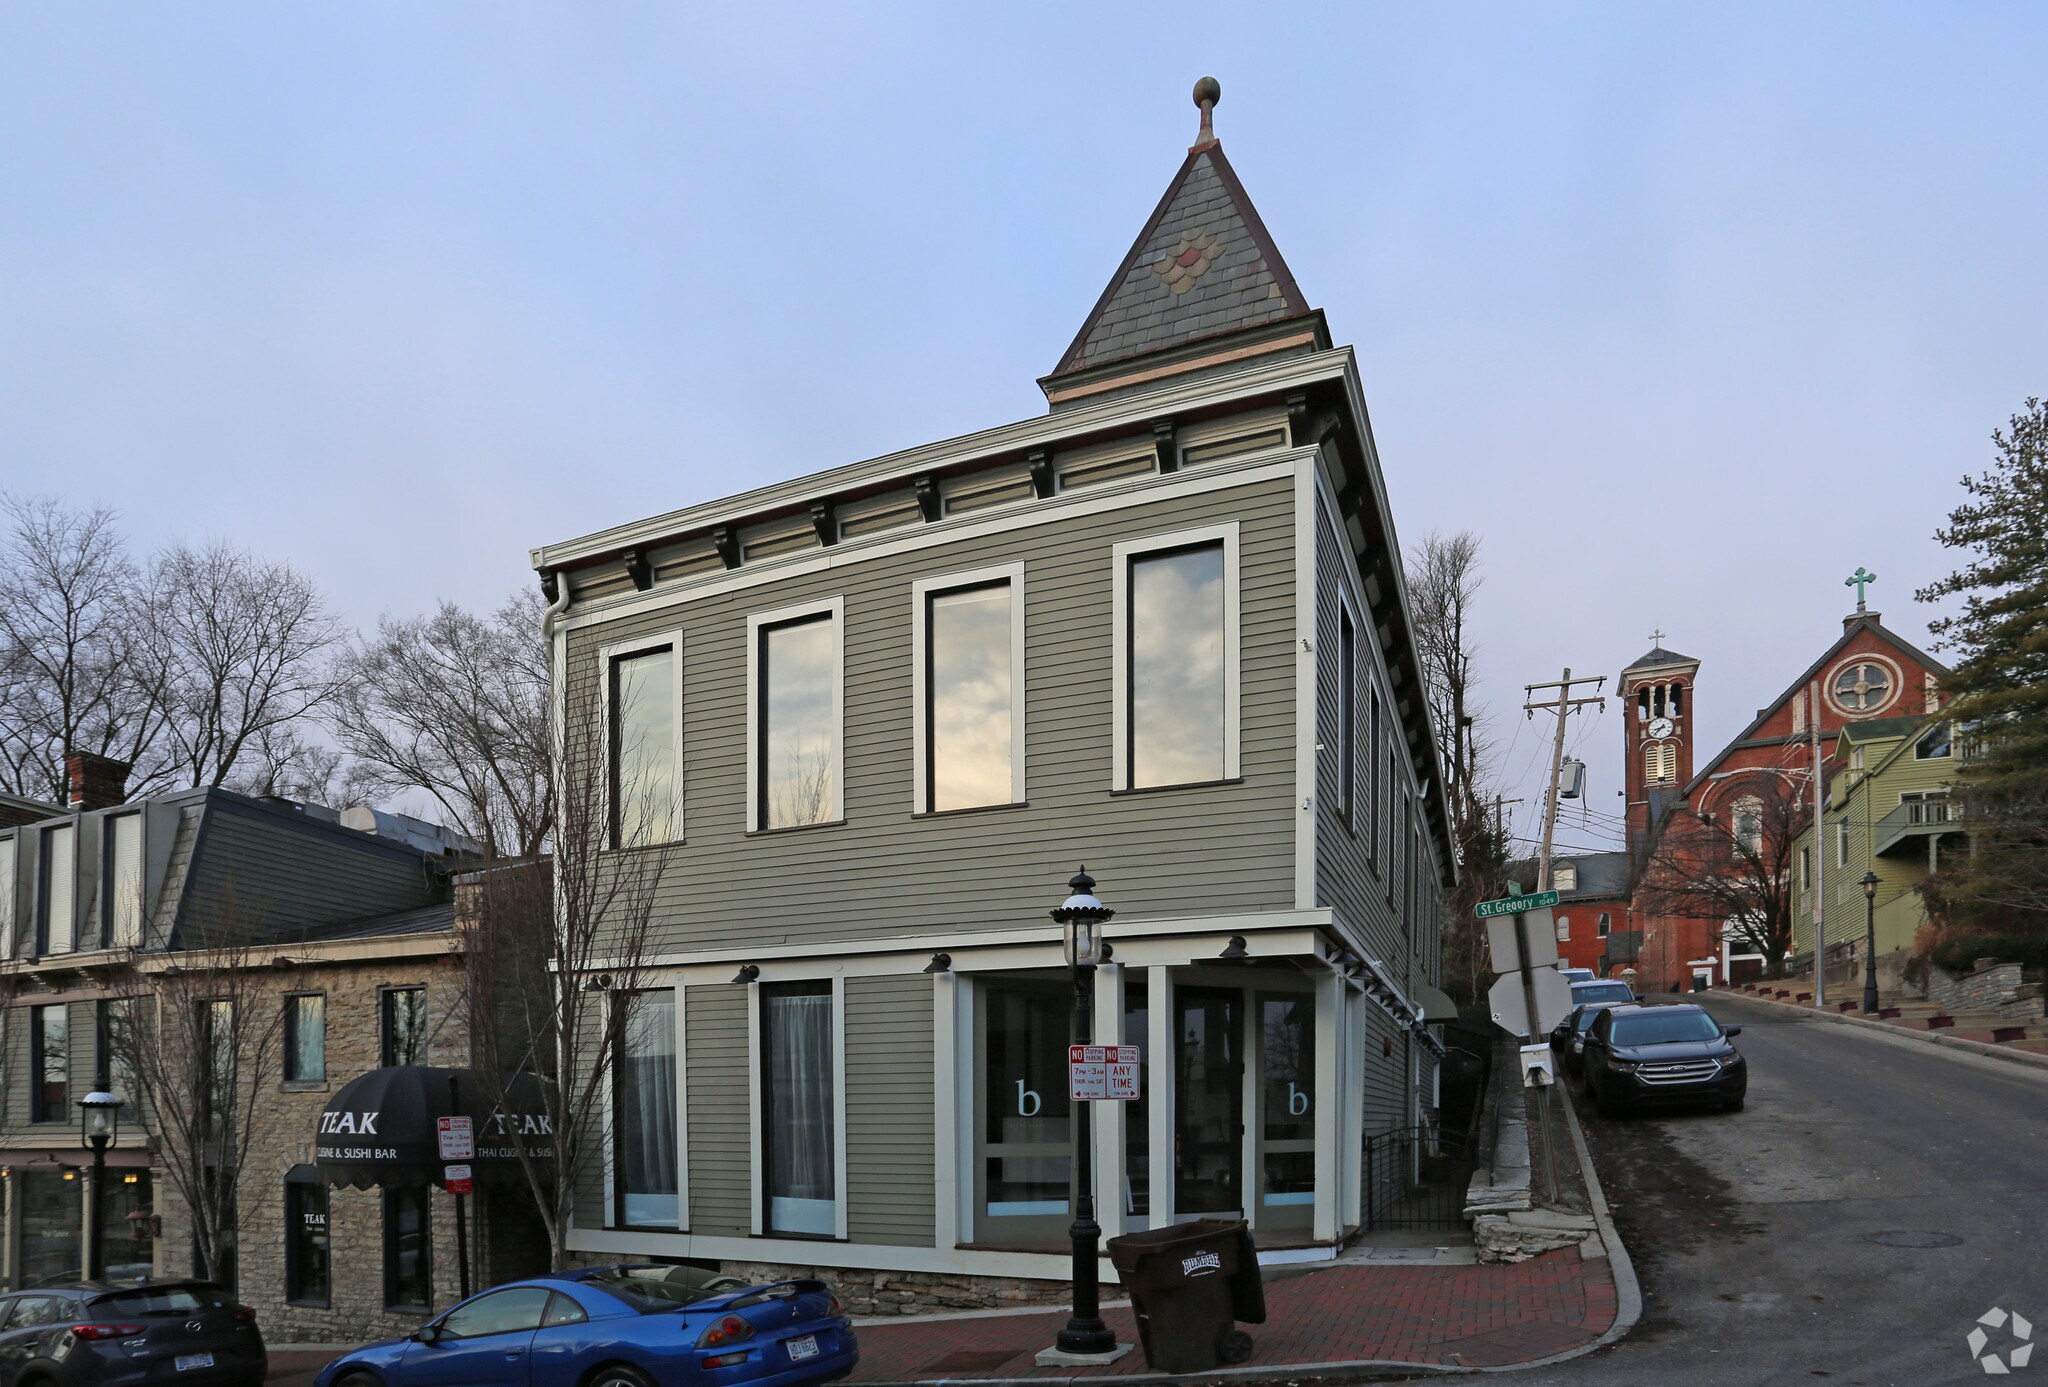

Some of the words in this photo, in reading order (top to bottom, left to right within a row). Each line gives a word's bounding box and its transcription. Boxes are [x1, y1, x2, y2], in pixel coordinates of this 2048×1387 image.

[1481, 904, 1495, 915] St.
[1495, 898, 1533, 913] Gregory
[1539, 898, 1554, 906] 1049
[1072, 1049, 1083, 1060] NO
[1106, 1050, 1117, 1060] NO
[1112, 1066, 1131, 1075] ANY
[1112, 1078, 1133, 1088] TIME
[1015, 1079, 1041, 1117] b
[1287, 1081, 1308, 1116] b
[320, 1112, 379, 1134] TEAK
[439, 1120, 450, 1128] NO
[335, 1147, 342, 1158] &
[344, 1147, 372, 1159] SUSHI
[375, 1148, 397, 1159] BAR
[478, 1147, 497, 1157] THAI
[529, 1147, 536, 1157] &
[537, 1147, 556, 1158] SUSH
[304, 1213, 326, 1224] TEAK
